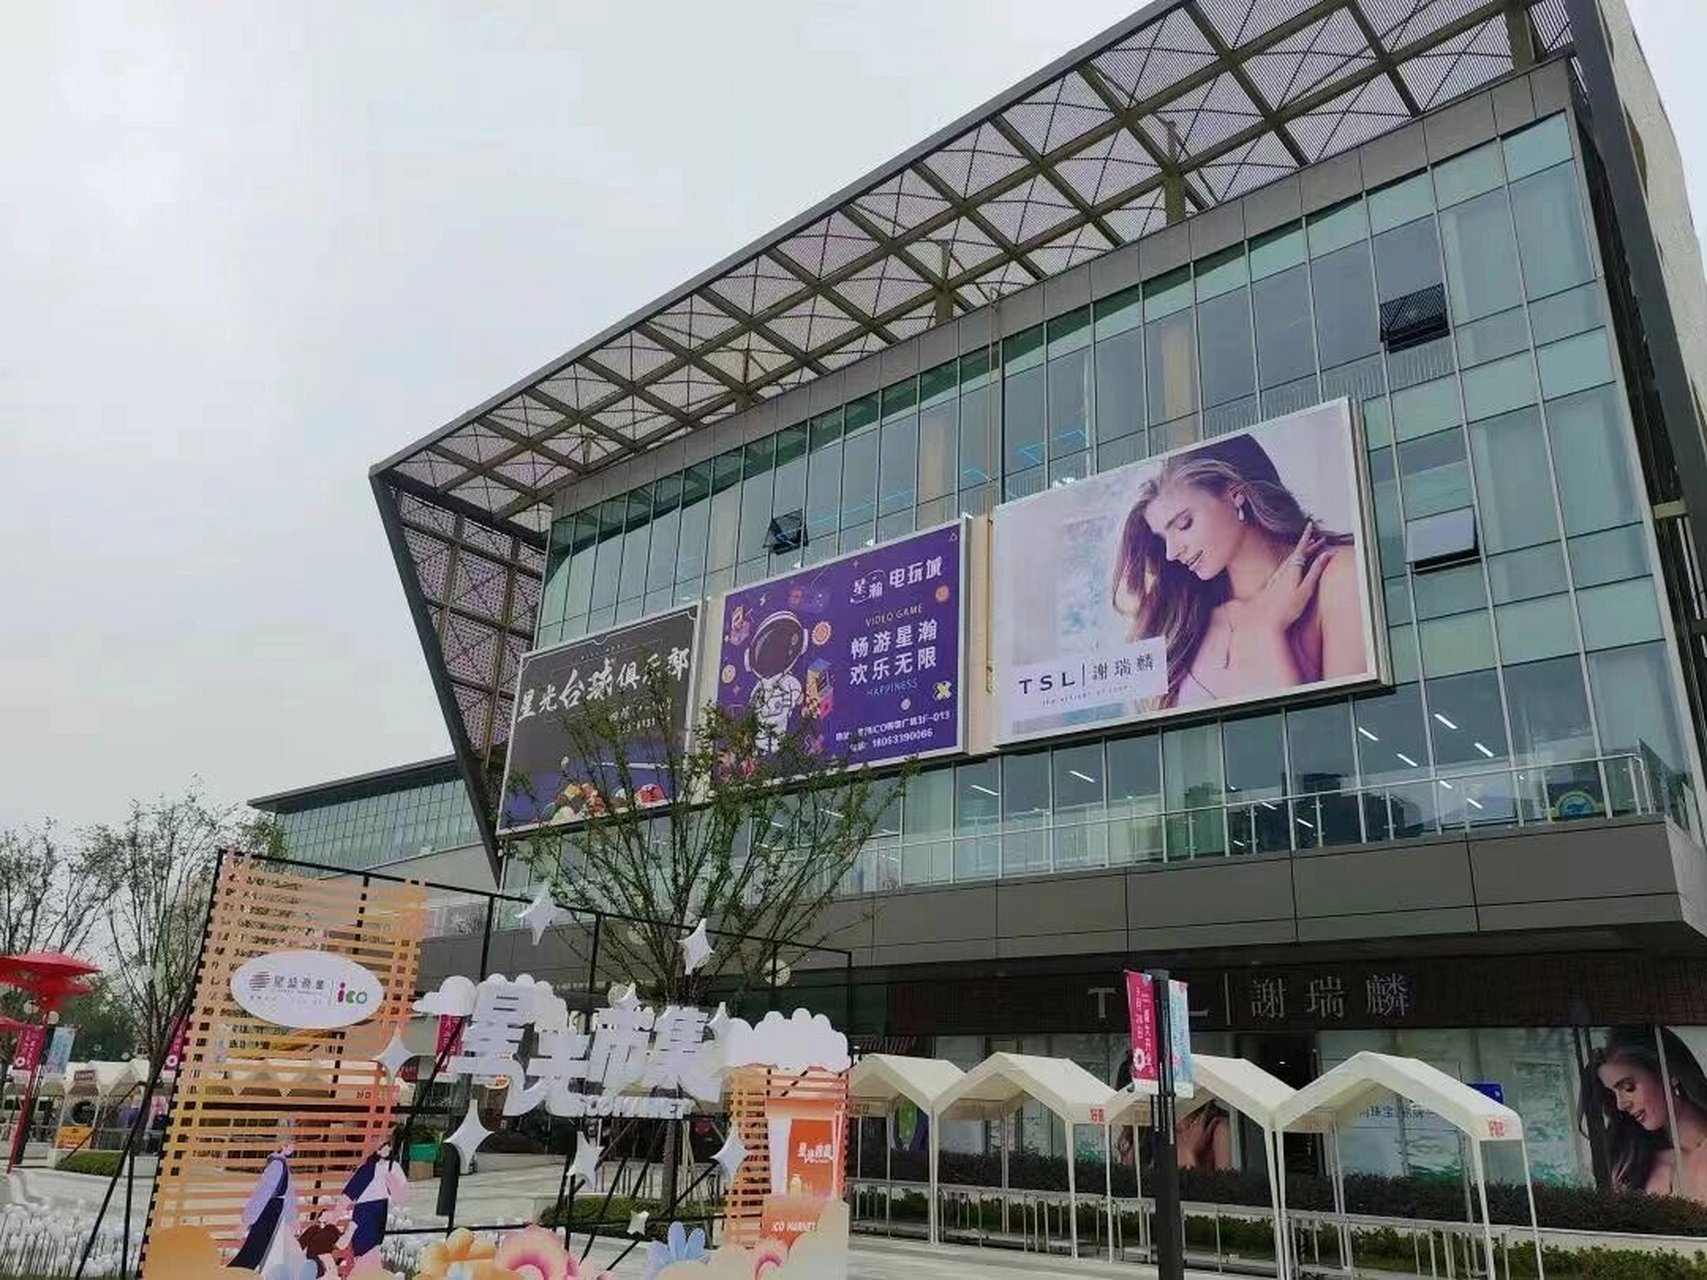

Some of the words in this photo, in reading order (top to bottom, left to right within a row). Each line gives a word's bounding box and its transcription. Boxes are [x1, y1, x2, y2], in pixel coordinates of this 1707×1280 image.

[889, 556, 942, 588] 电玩城
[895, 603, 924, 619] GAME
[851, 619, 937, 659] 畅游星瀚
[850, 646, 937, 685] 欢乐无限
[1093, 653, 1153, 681] 謝瑞麟
[1018, 671, 1076, 695] TSL
[1251, 971, 1411, 1020] 謝瑞麟
